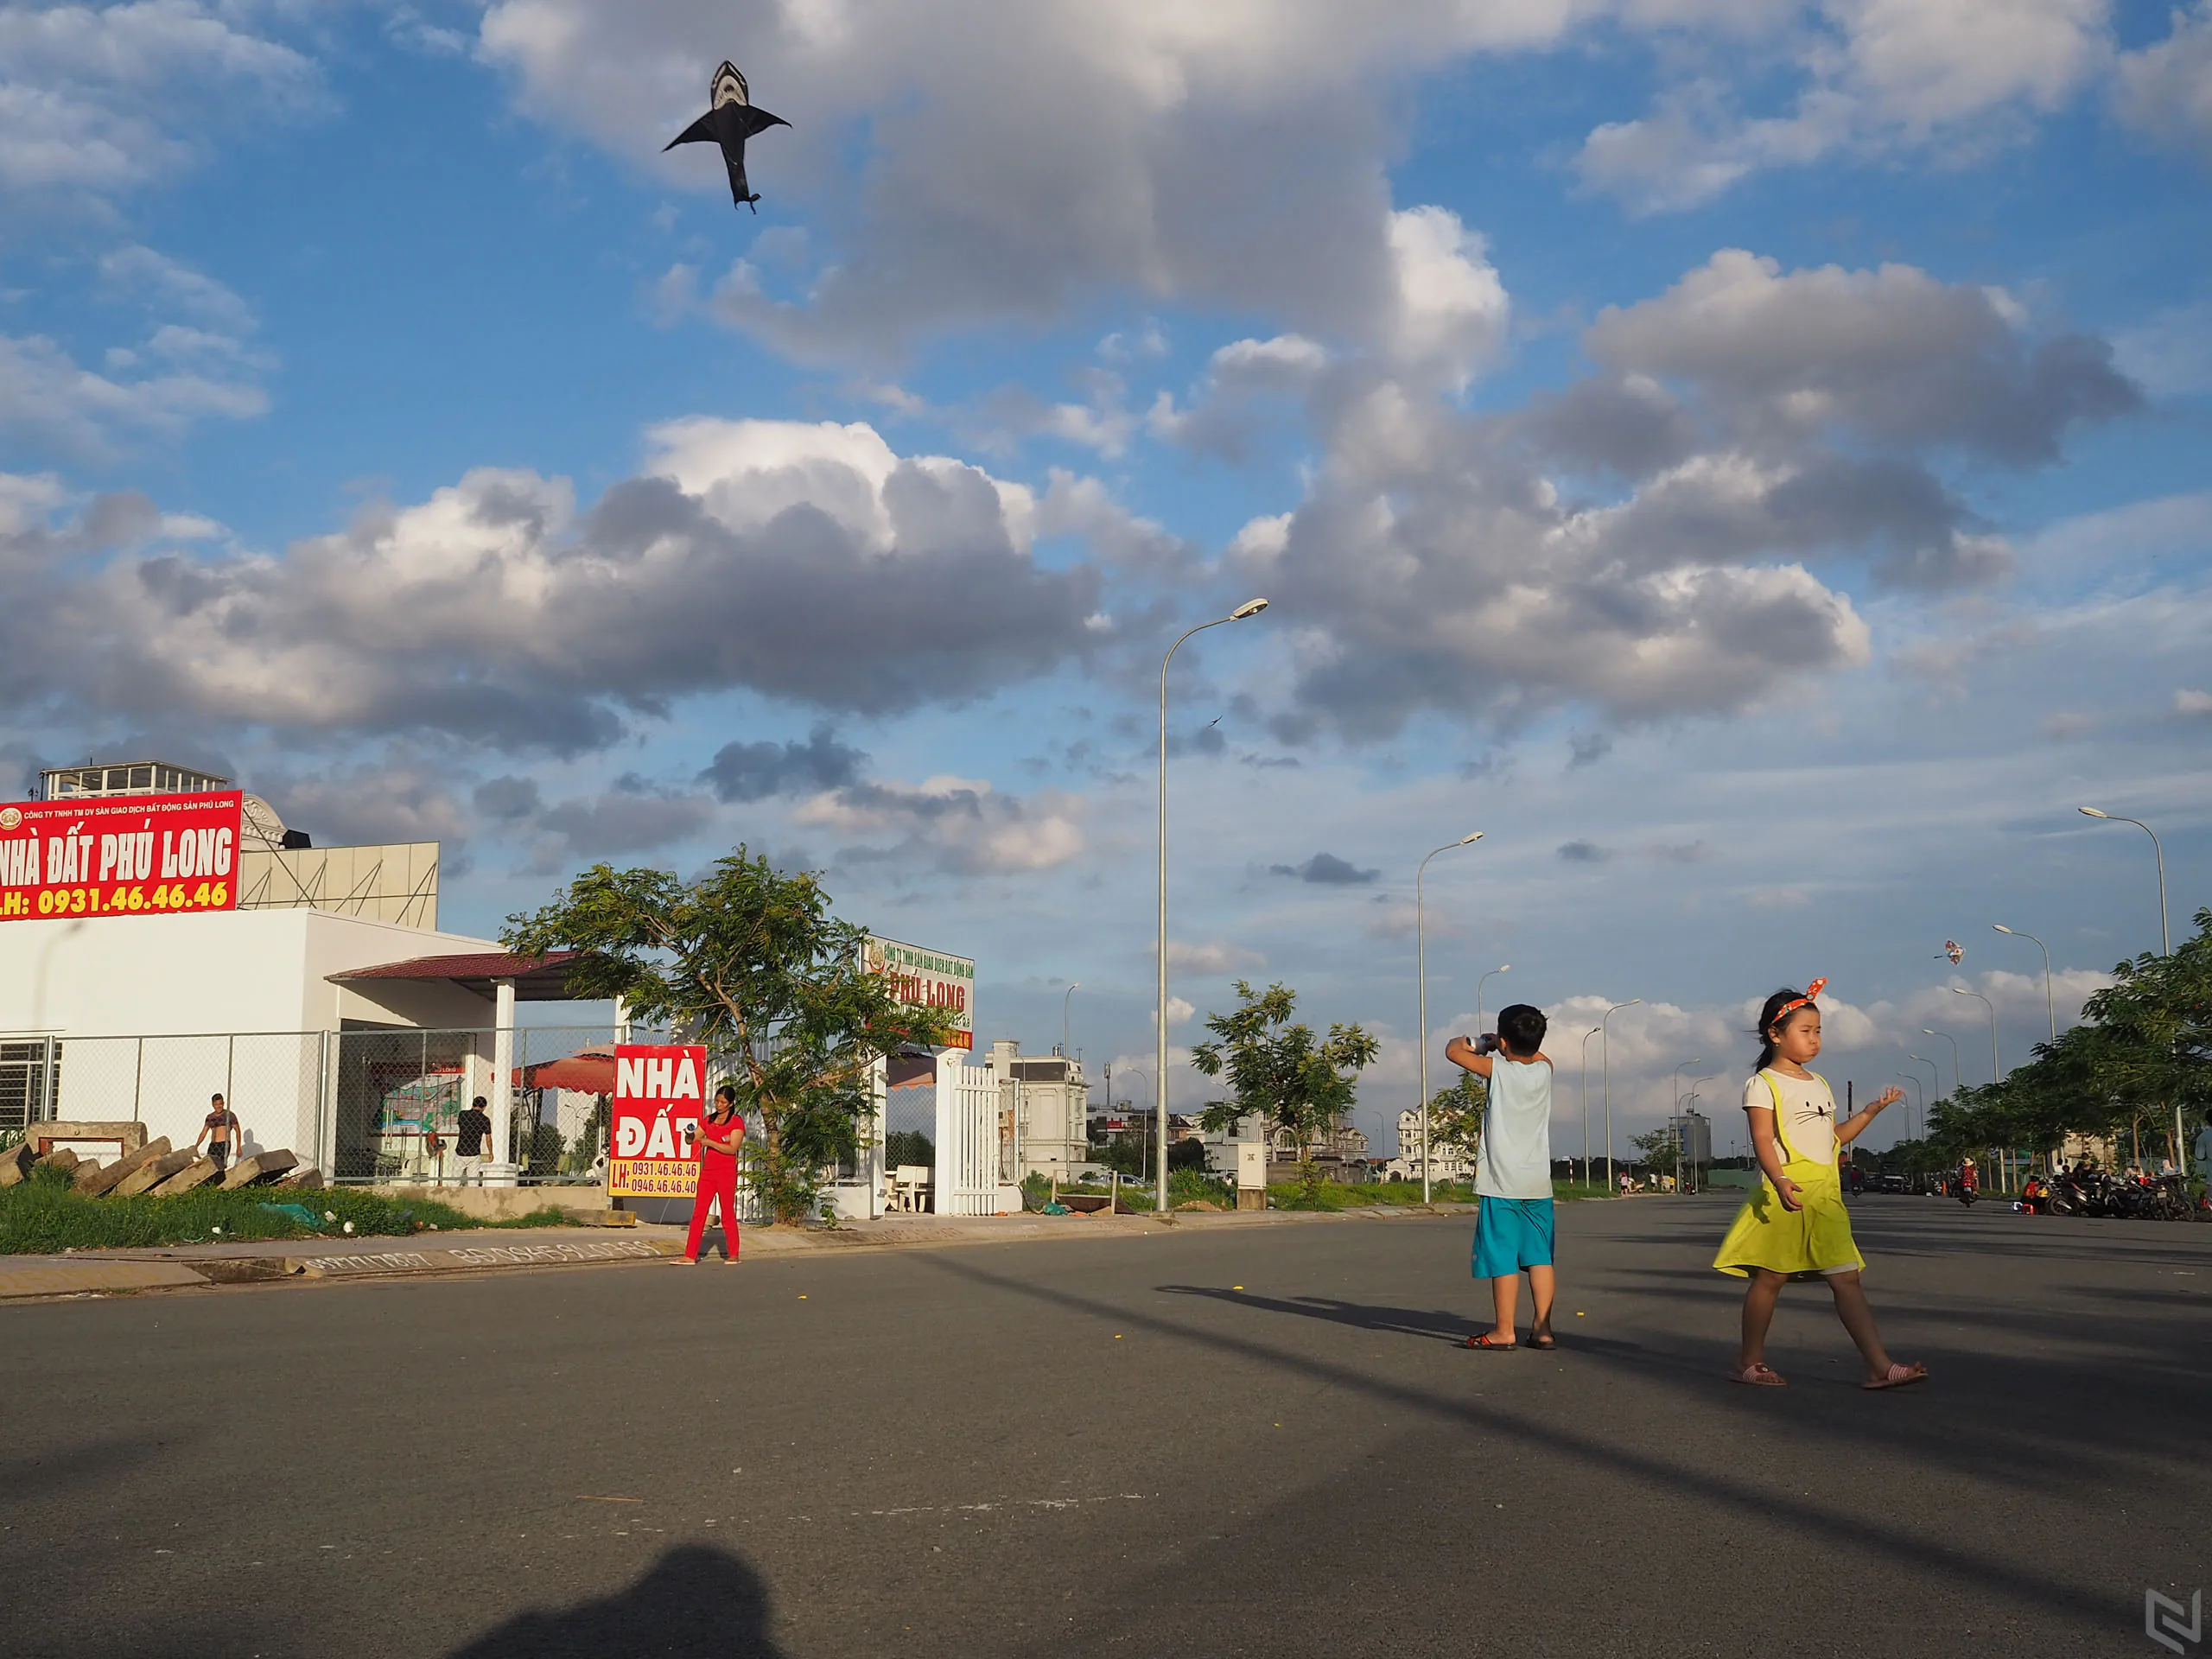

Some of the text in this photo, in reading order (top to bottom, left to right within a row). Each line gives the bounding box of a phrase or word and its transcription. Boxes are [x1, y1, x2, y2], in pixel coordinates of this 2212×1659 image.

[24, 810, 43, 819] CÔNG
[95, 806, 110, 815] SÀN
[111, 806, 127, 815] GIAO
[129, 805, 145, 814] DỊCH
[146, 802, 161, 812] BẤT
[162, 802, 181, 812] ĐỘNG
[183, 800, 198, 810] SẢN
[199, 799, 213, 809] PHÚ
[0, 818, 232, 887] NHÀ ĐẤT PHÚ LONG
[0, 881, 227, 915] H: 0931.46.46.46
[927, 979, 965, 1011] LONG
[616, 1050, 700, 1099] NHÀ
[615, 1103, 698, 1159] ĐẤT
[612, 1162, 696, 1188] LH: 0931.46.46.46
[632, 1179, 696, 1193] 0946.46.46.40
